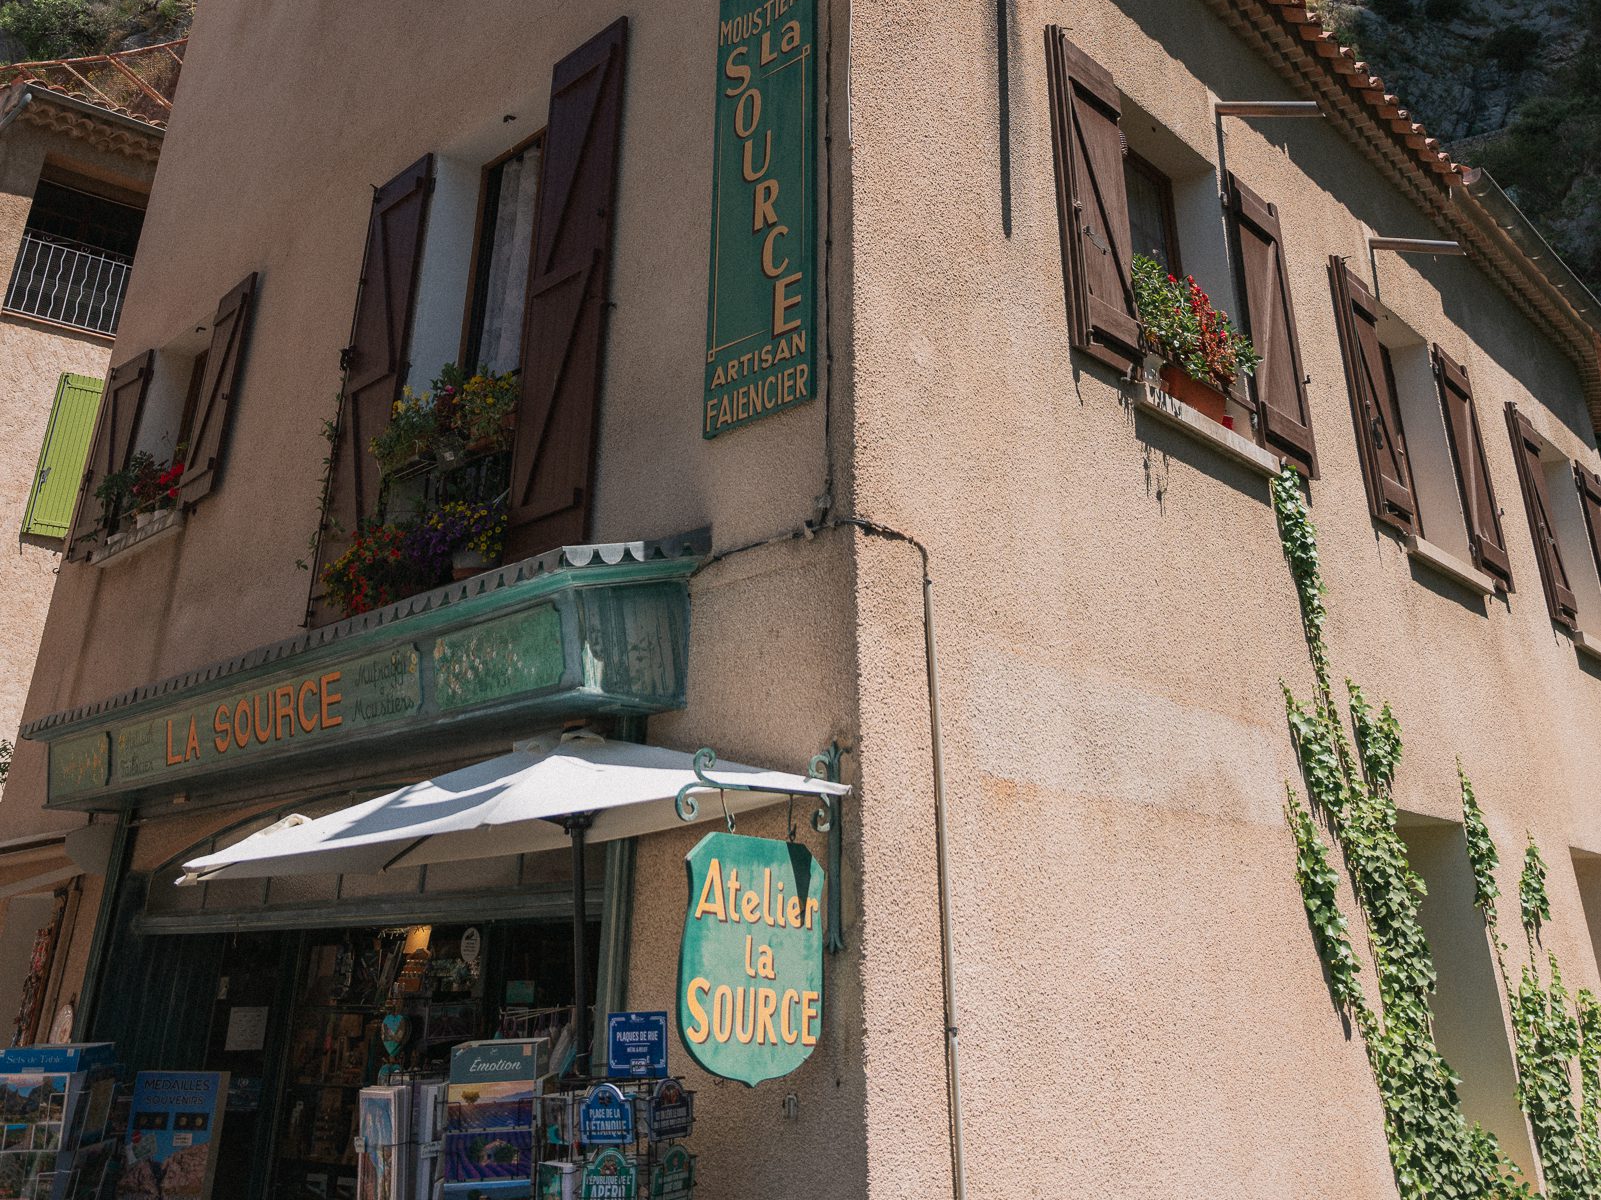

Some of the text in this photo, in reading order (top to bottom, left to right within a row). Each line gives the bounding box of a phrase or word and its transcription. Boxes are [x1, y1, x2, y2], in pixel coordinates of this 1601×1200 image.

[760, 19, 801, 66] La
[724, 46, 802, 337] SOURCE
[710, 329, 806, 390] ARTISAN
[705, 363, 809, 432] FAIENCIER
[167, 670, 344, 766] LA SOURCE
[694, 857, 819, 931] Atelier
[744, 934, 776, 979] la
[616, 1030, 659, 1042] PLAQUES DE RUE
[686, 976, 820, 1045] SOURCE
[469, 1055, 522, 1073] Émotion
[145, 1095, 205, 1105] SOUVENIRS
[589, 1108, 621, 1118] PLACE DE LA
